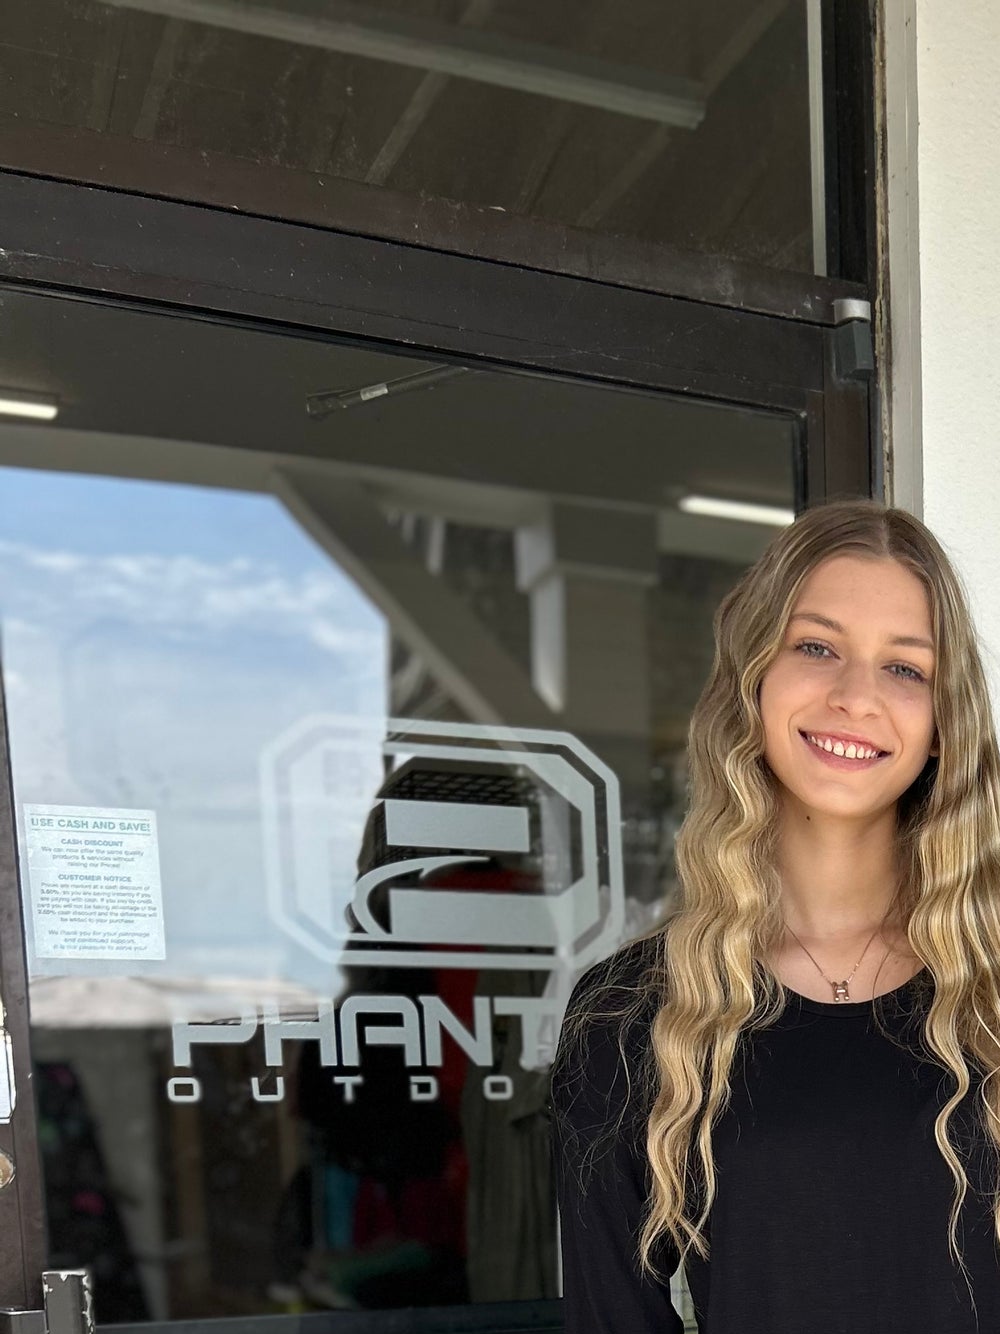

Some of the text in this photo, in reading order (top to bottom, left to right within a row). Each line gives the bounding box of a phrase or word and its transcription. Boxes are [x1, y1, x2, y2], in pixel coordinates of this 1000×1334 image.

[30, 817, 150, 831] USE CASH AND SAVE!
[57, 873, 101, 881] CUSTOMER
